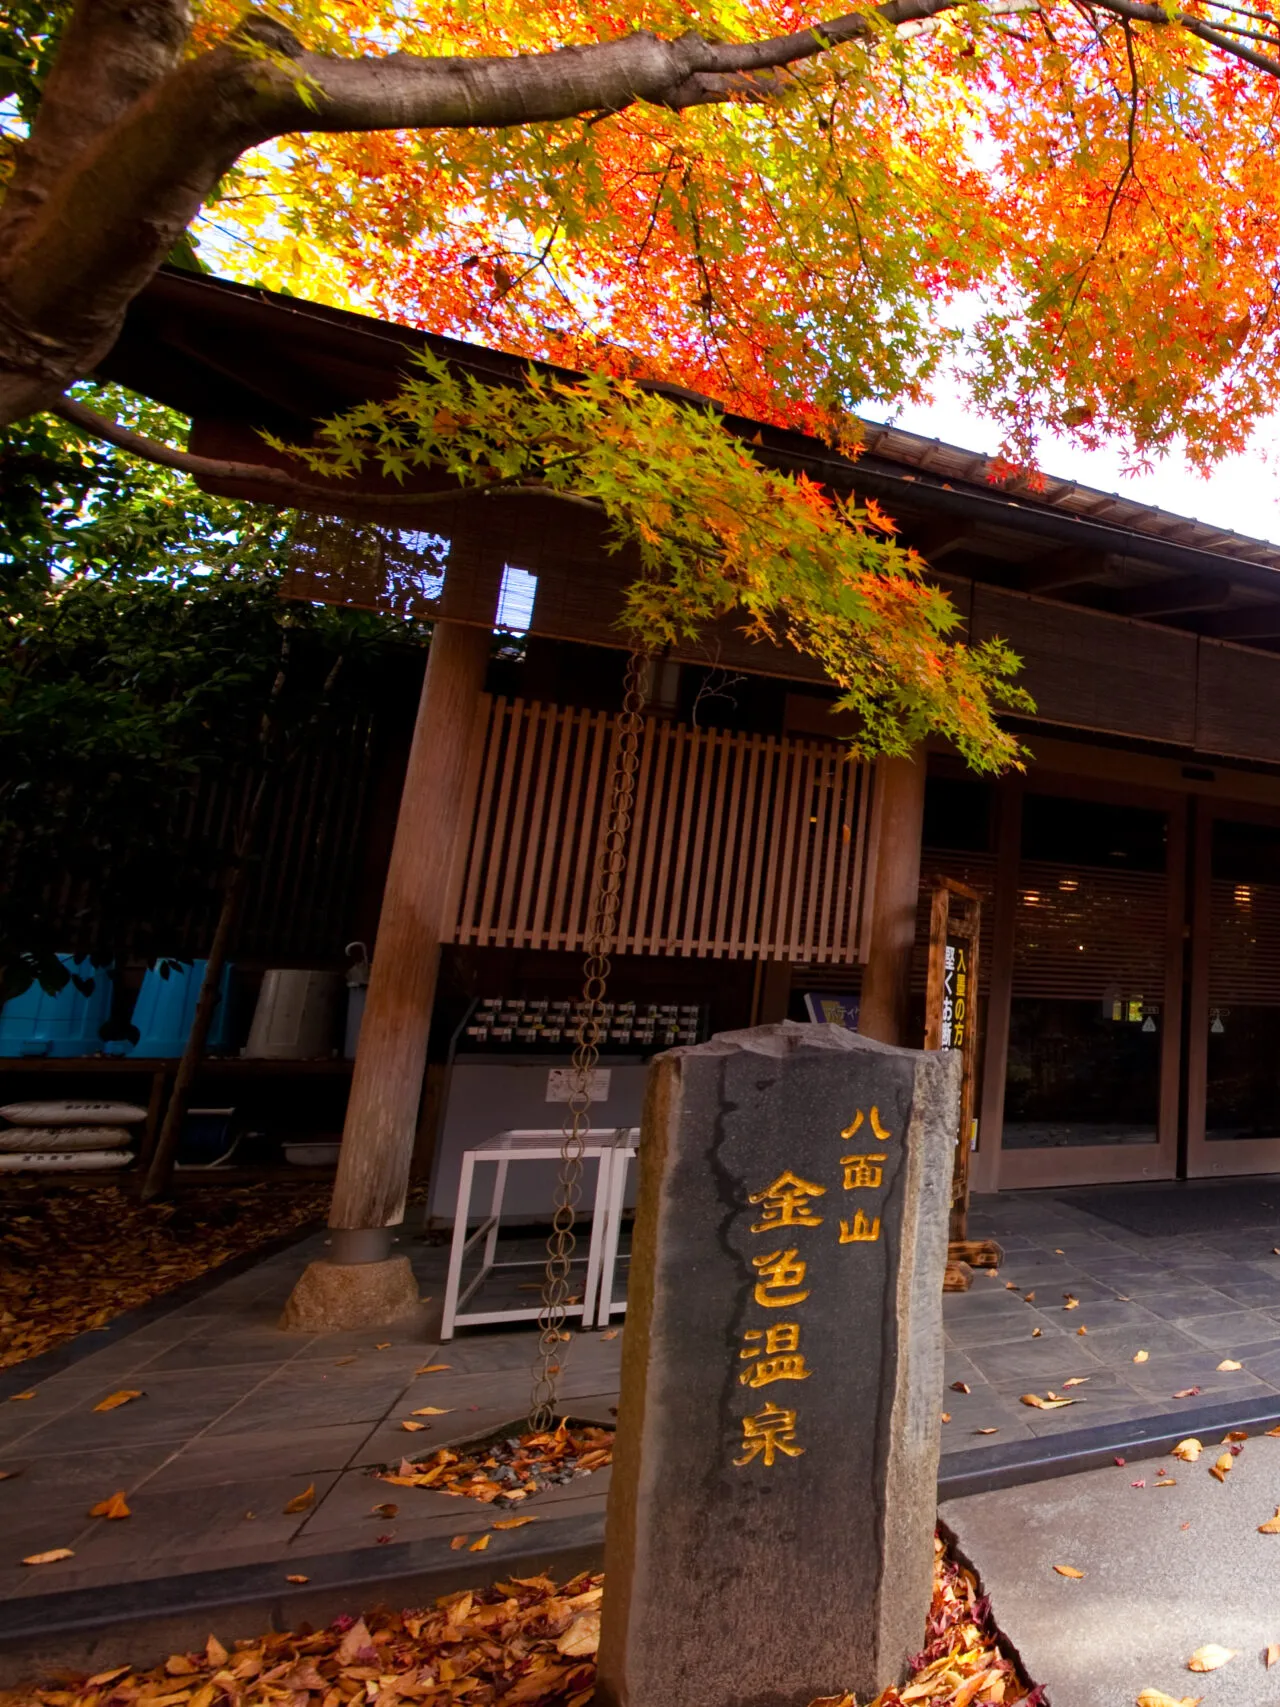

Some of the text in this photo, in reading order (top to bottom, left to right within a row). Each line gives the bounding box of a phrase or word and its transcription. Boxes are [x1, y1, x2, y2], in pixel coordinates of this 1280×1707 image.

[942, 945, 956, 1053] 堅くお断
[954, 948, 967, 1046] 入墨の方
[838, 1105, 893, 1245] 八面山
[732, 1169, 828, 1468] 金色温泉
